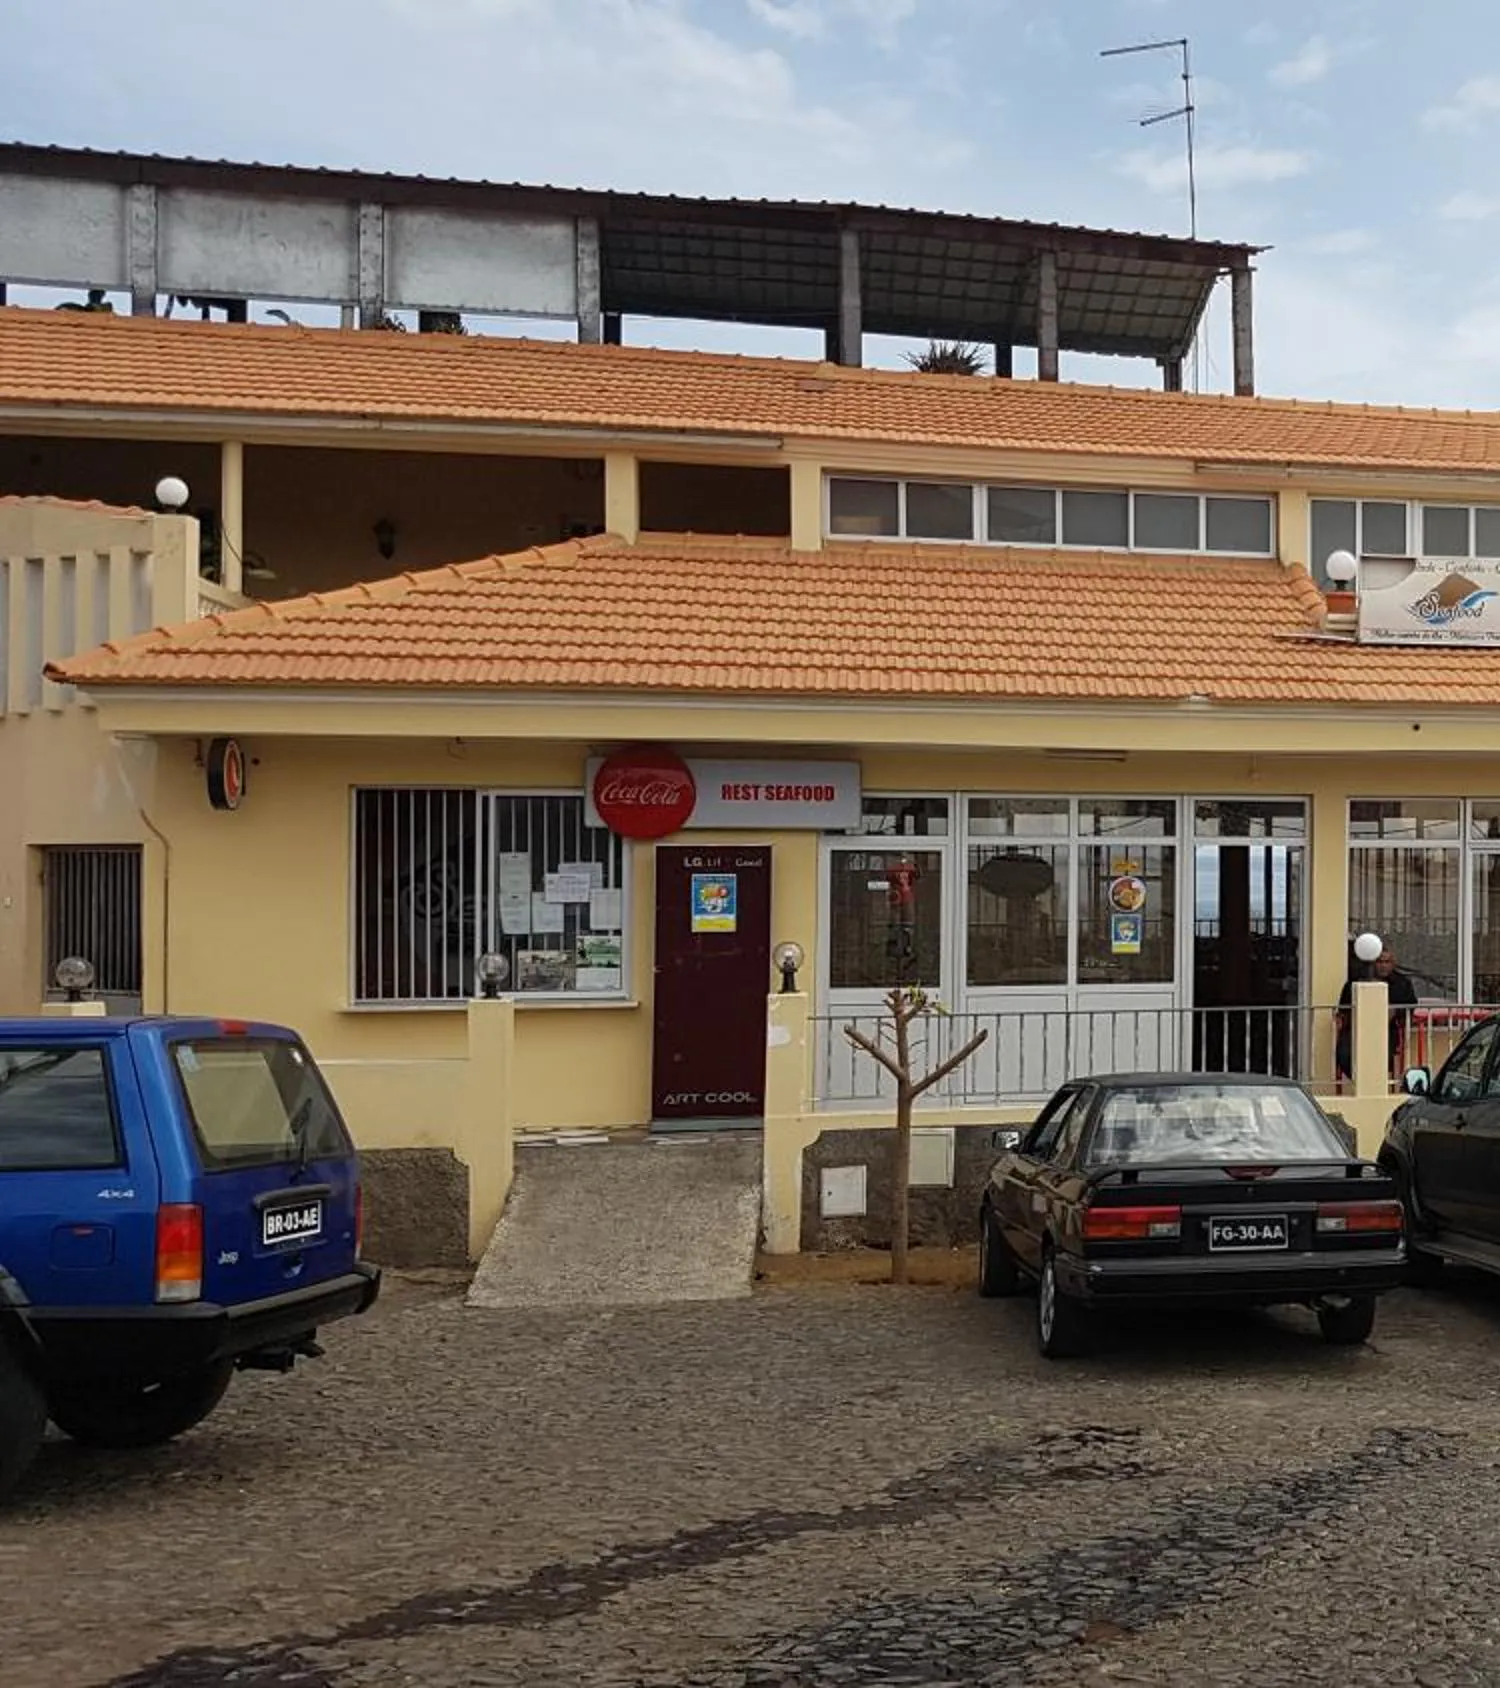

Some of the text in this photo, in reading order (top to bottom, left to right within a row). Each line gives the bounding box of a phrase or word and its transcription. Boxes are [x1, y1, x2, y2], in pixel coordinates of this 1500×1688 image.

[1417, 591, 1485, 623] Seafood
[721, 783, 835, 802] REST SEAFOOD
[683, 857, 703, 868] LG
[664, 1091, 757, 1105] ART COOL
[267, 1207, 318, 1234] BR-03-AE
[1213, 1225, 1285, 1240] FG-30-AA
[217, 1250, 239, 1265] Jeep
